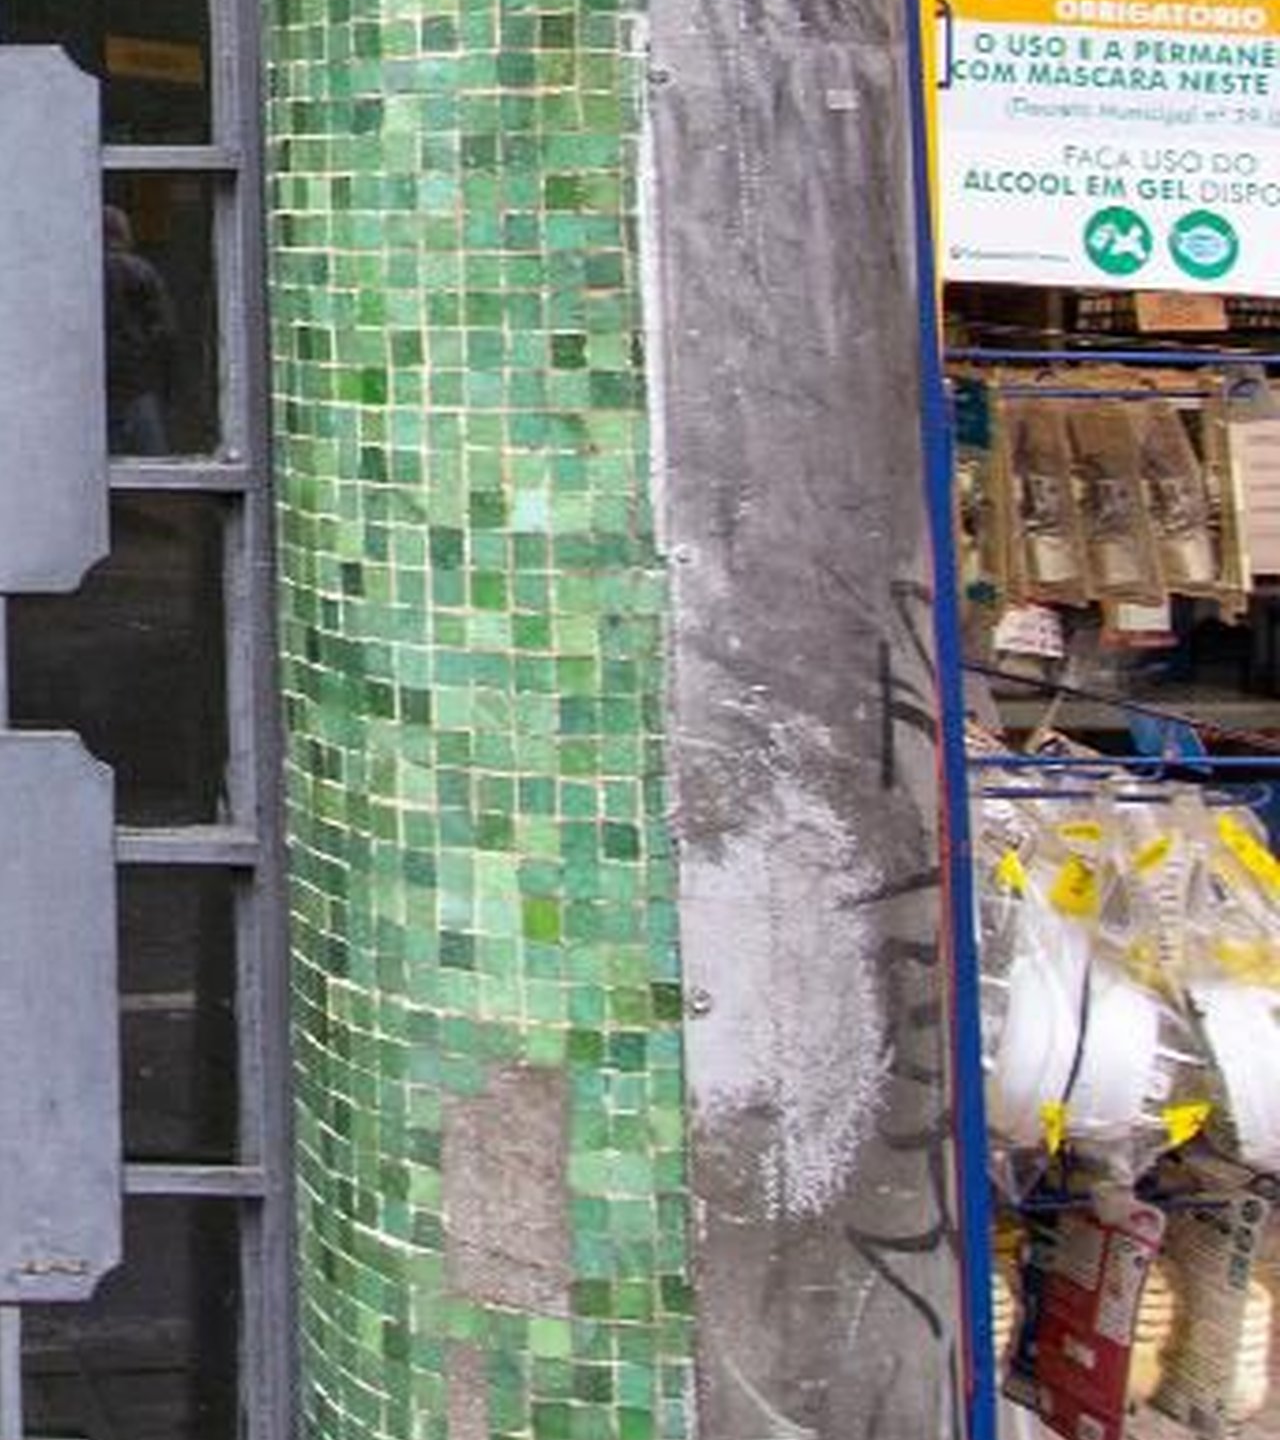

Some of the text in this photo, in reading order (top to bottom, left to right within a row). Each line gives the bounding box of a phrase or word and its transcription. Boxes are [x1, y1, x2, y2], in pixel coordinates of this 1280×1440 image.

[974, 32, 995, 54] O
[1007, 34, 1067, 58] USO
[1078, 38, 1093, 61] E
[1102, 40, 1123, 61] A
[951, 59, 1017, 82] COM
[1178, 70, 1269, 96] NESTE
[1141, 148, 1203, 174] USO
[1211, 151, 1258, 177] DO
[1086, 174, 1126, 197] EM
[1136, 177, 1190, 201] GEL
